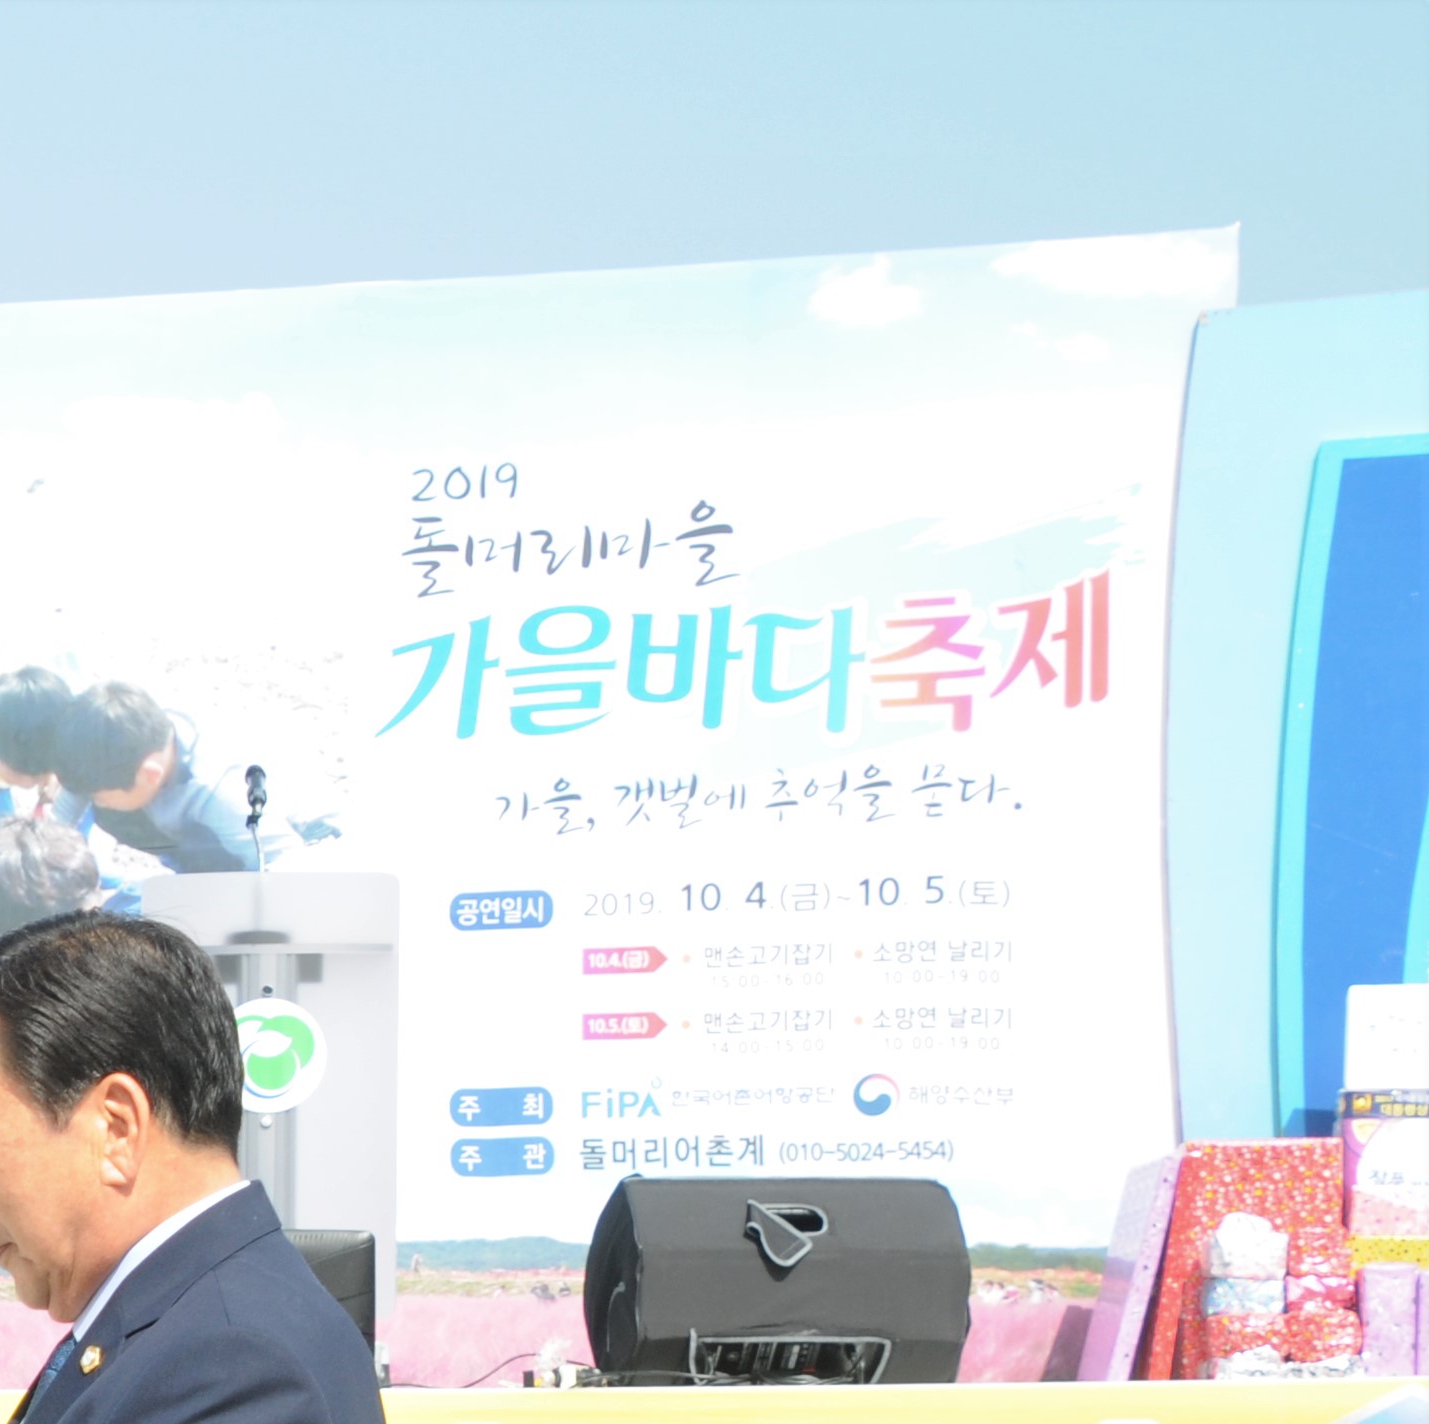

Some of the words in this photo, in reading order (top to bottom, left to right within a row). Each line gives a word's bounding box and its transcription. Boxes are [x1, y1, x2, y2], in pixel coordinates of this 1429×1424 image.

[411, 462, 520, 502] 2019
[402, 499, 741, 599] 돌머리마을
[374, 568, 1112, 740] 가을바다축제
[495, 776, 597, 835] 가을,
[614, 773, 748, 830] 갯벌에
[764, 763, 896, 822] 추억을
[456, 896, 545, 927] 공연일시
[703, 943, 834, 968] 맨손고기잡기
[872, 940, 939, 963] 소망연
[947, 939, 1013, 964] 날리기
[703, 1008, 834, 1034] 맨손고기잡기
[872, 1006, 939, 1030] 소망연
[947, 1005, 1013, 1031] 날리기
[907, 1086, 1014, 1107] 해양수산부
[579, 1134, 765, 1171] 돌머리어촌계
[778, 1138, 955, 1165] (010-5024-5454)
